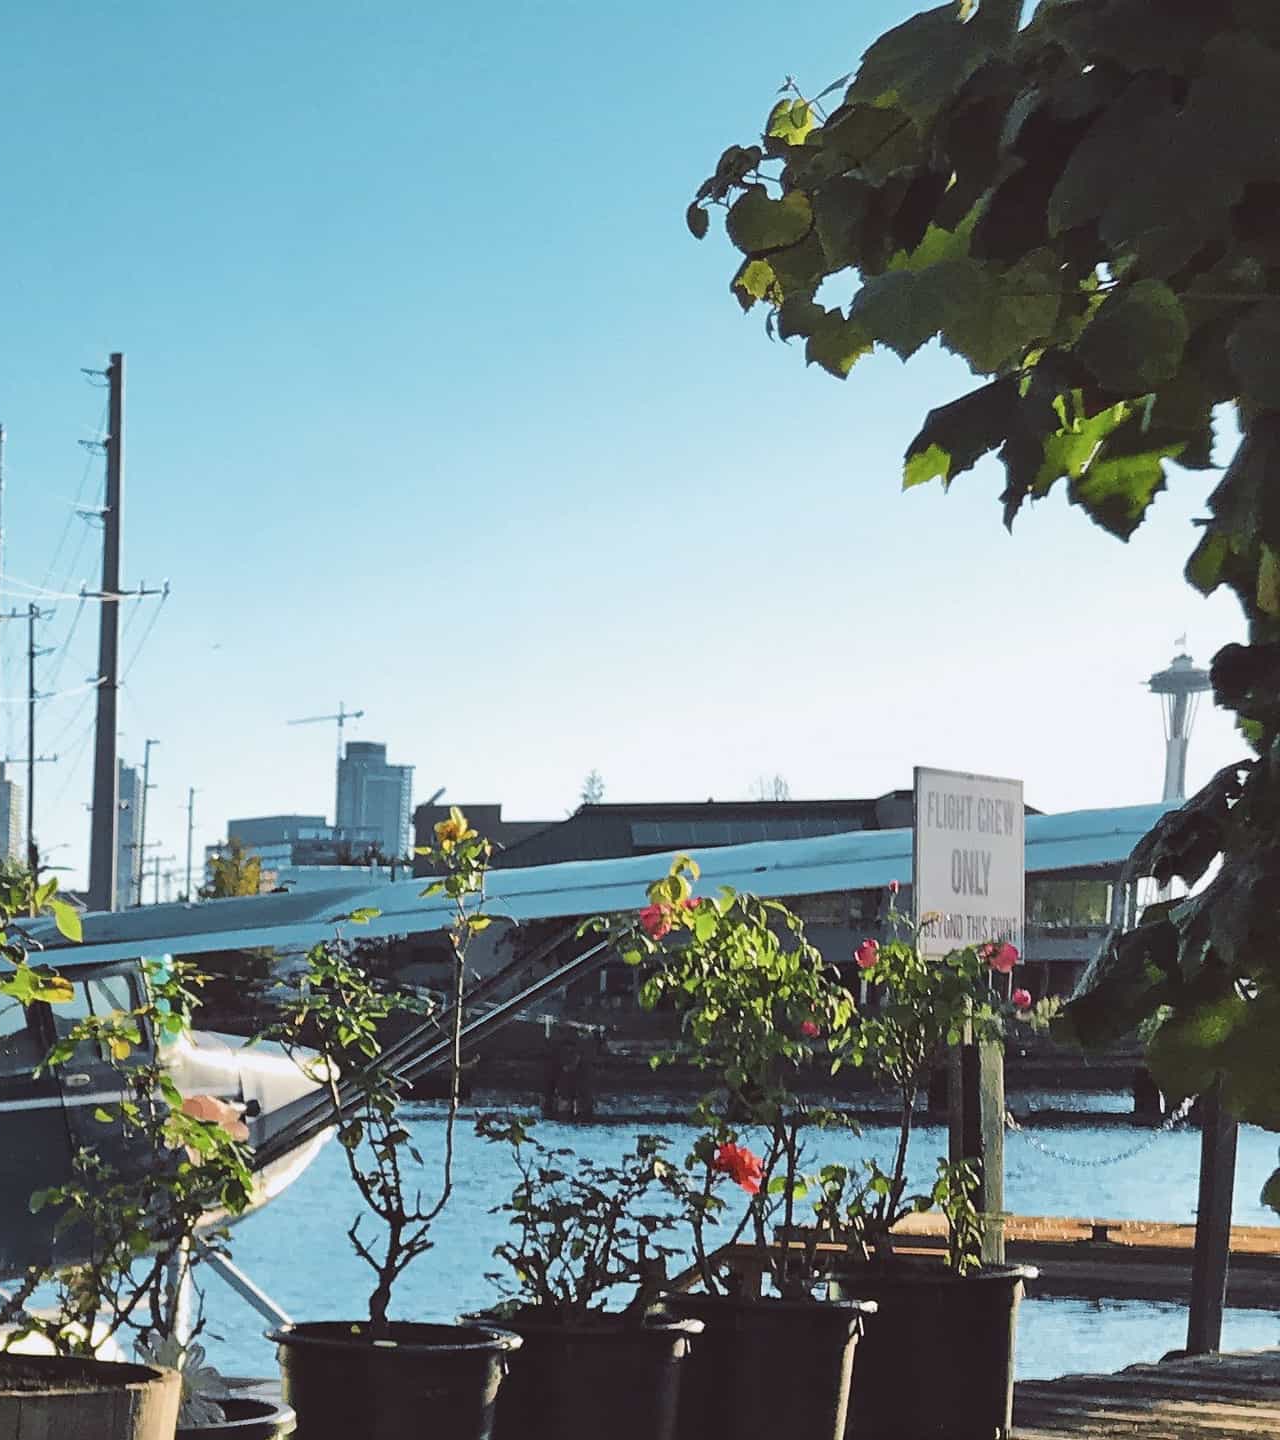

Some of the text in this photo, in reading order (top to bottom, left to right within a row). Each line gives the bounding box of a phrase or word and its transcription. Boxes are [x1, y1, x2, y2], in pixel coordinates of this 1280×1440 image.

[927, 792, 1015, 836] FLIGHT CREW
[951, 849, 992, 897] ONLY
[967, 915, 988, 941] THIS
